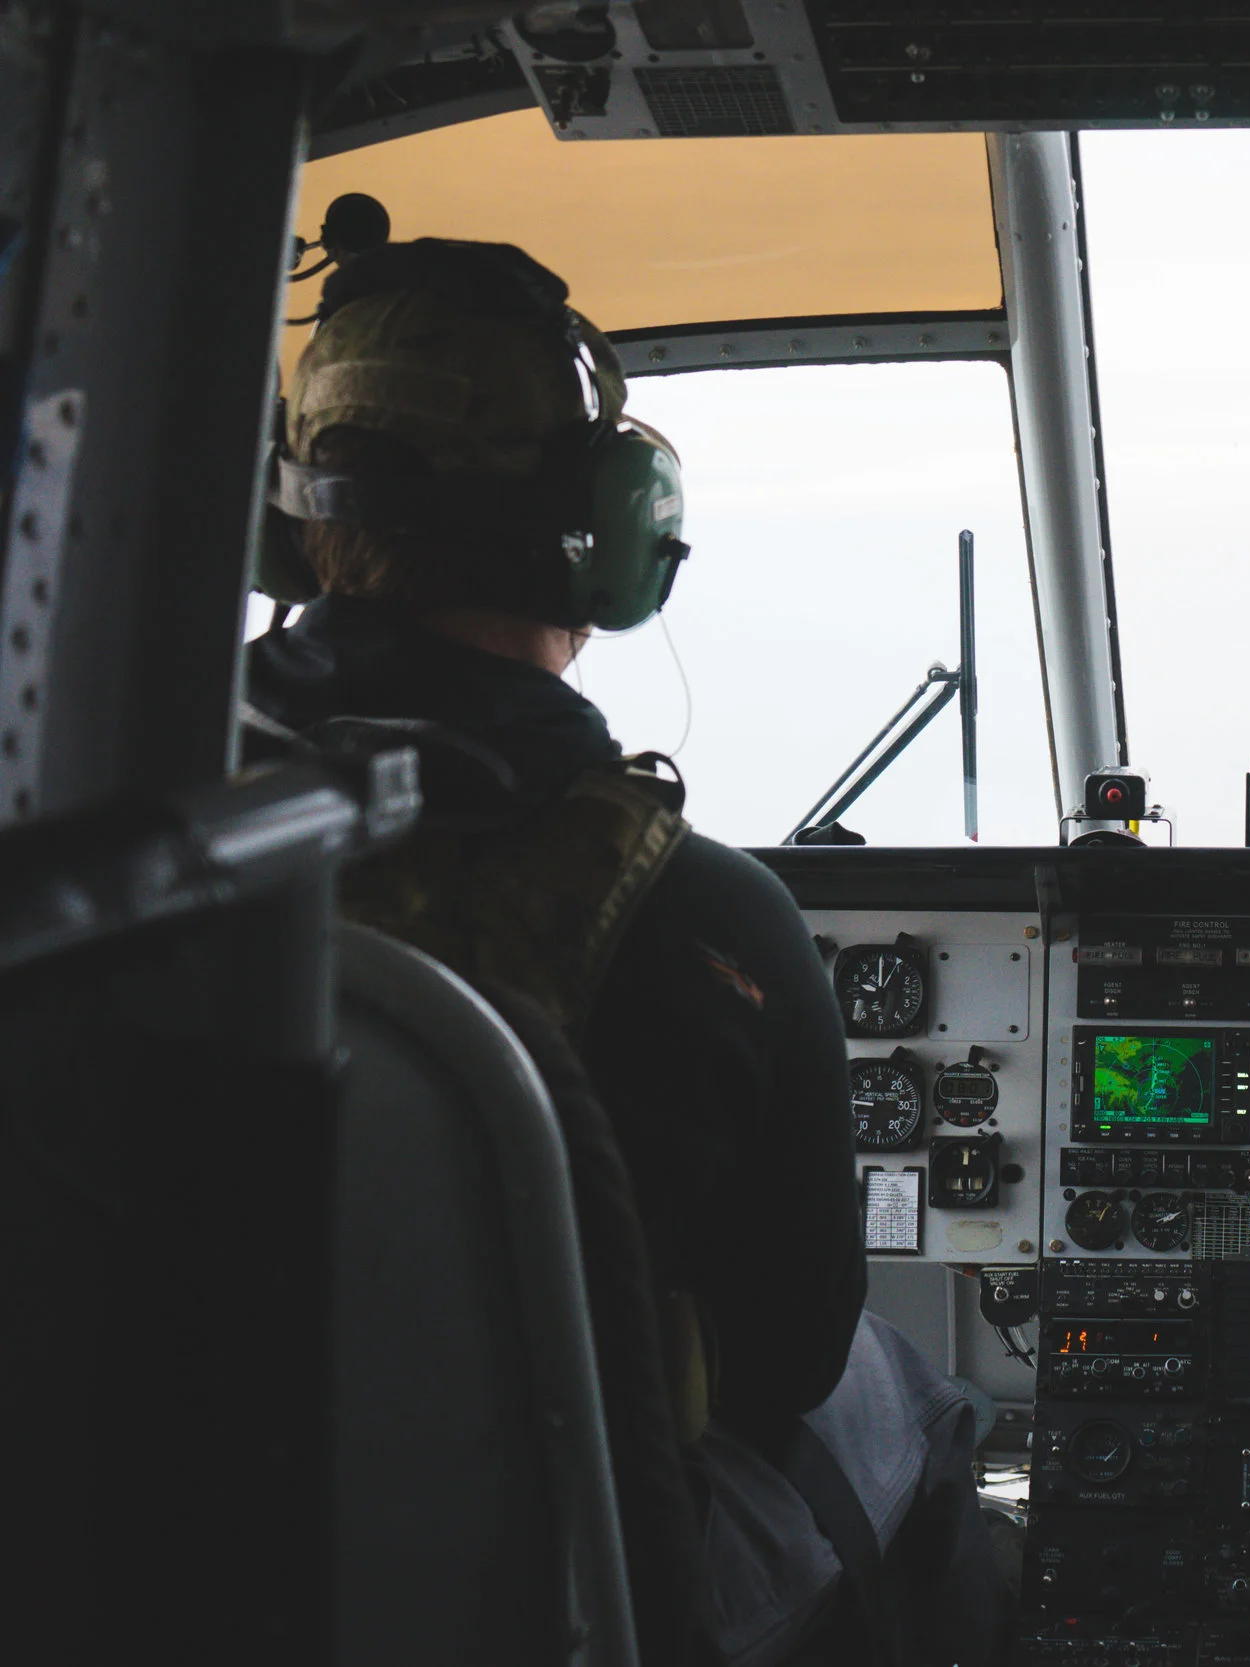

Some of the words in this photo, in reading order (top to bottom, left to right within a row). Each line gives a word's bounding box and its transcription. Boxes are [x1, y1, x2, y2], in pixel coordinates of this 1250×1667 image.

[904, 976, 910, 985] 2
[904, 999, 910, 1008] 3
[878, 1016, 884, 1024] 5
[862, 1080, 872, 1089] 10
[891, 1080, 904, 1090] 20
[898, 1101, 910, 1110] 30
[860, 1121, 868, 1130] 10
[888, 1120, 901, 1130] 20
